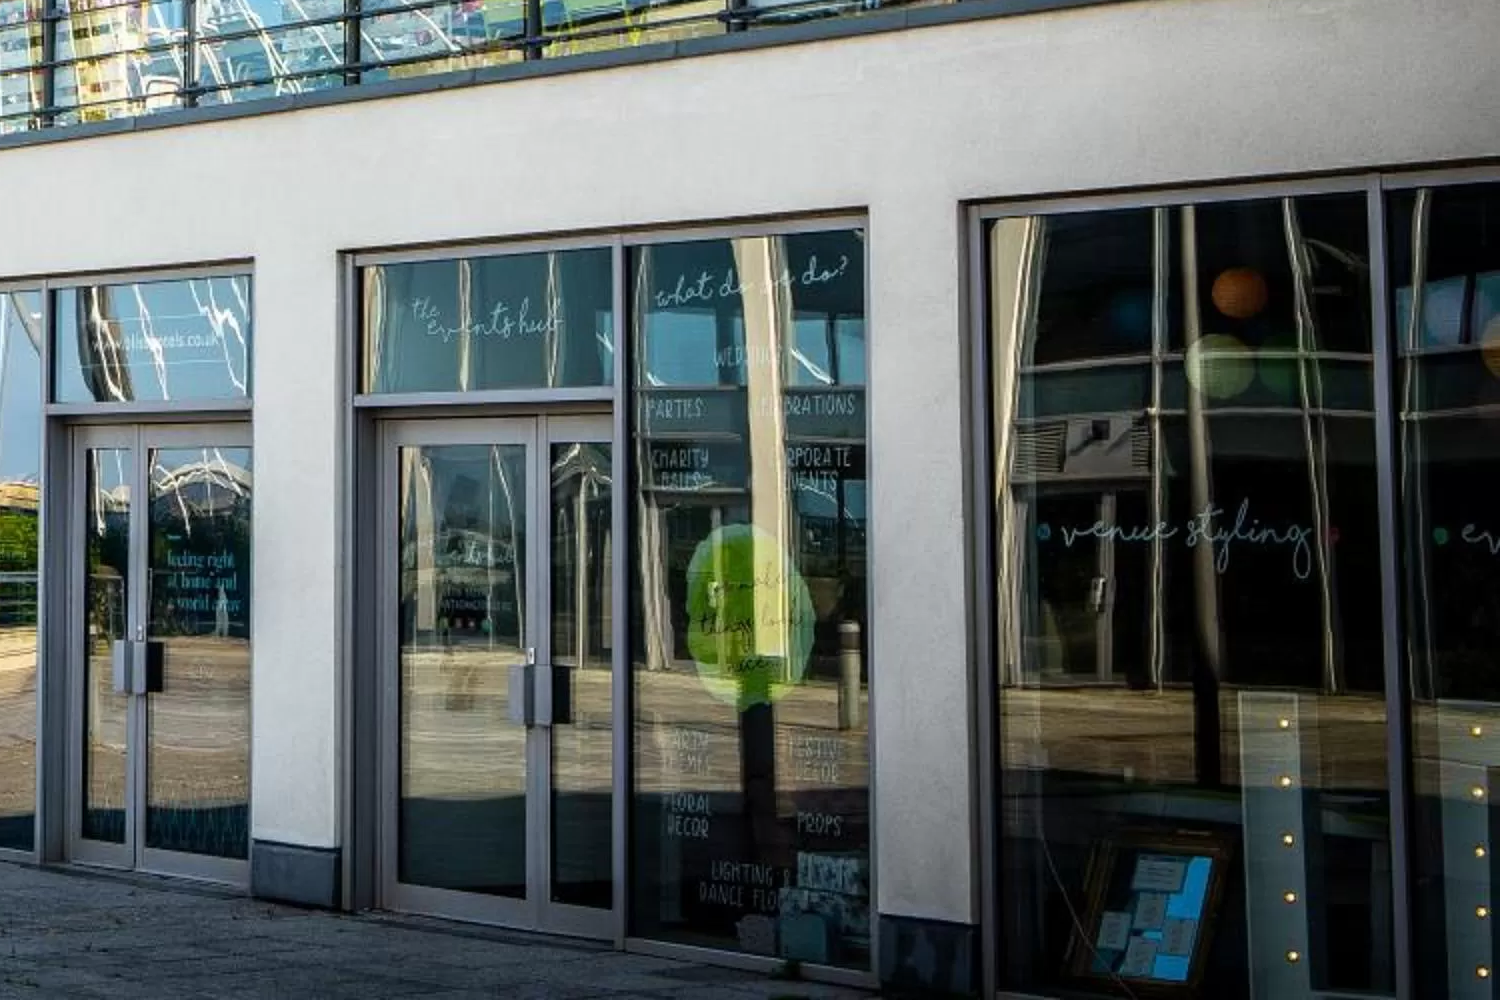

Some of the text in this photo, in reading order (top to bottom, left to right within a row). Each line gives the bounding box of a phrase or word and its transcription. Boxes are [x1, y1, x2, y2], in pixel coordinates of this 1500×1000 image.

[655, 271, 714, 307] what
[801, 255, 849, 285] do?
[412, 296, 440, 320] the
[646, 397, 703, 419] PARTIES
[652, 447, 709, 470] CHARITY
[778, 446, 852, 468] RPORATE
[1061, 497, 1312, 579] venue styling
[796, 811, 844, 837] PROPS
[711, 859, 773, 886] LIGHTING
[699, 881, 745, 908] DANCE
